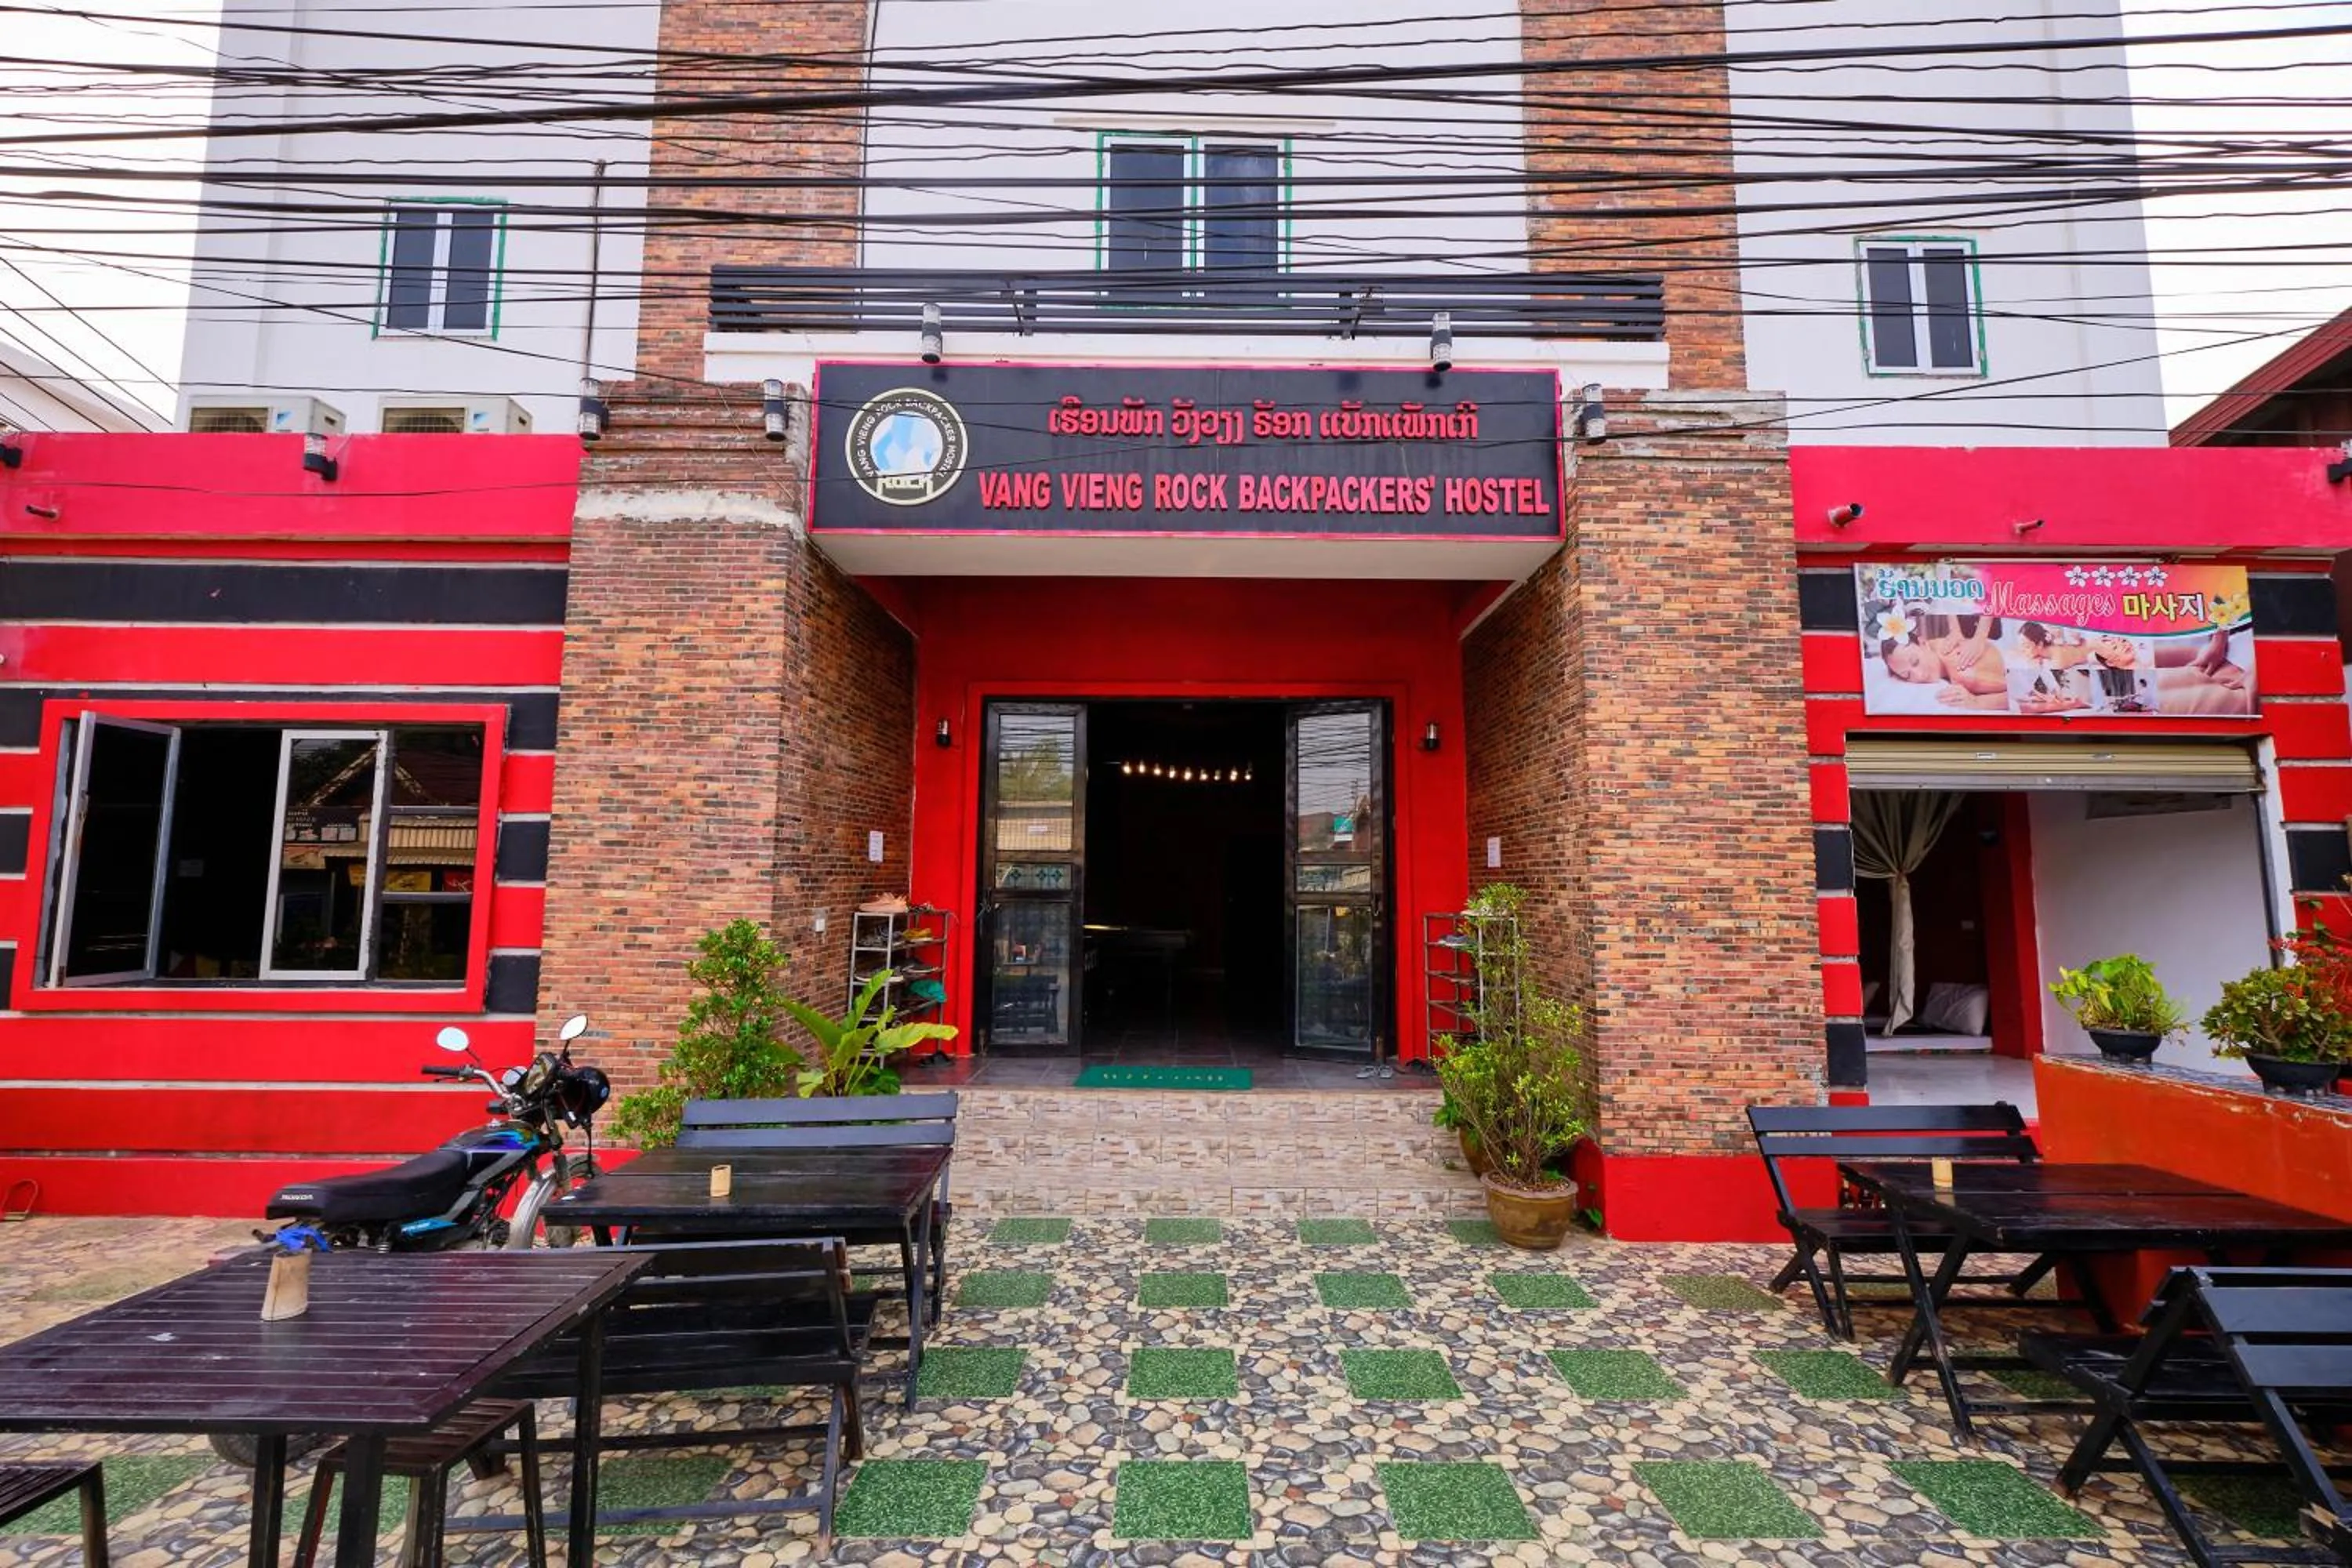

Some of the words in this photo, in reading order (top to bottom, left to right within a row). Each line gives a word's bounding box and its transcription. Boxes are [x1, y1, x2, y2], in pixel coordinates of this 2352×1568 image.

[856, 416, 876, 446] VIENG
[978, 470, 1052, 510] VANG
[1061, 472, 1143, 510] VIENG
[1154, 473, 1229, 511] ROCK
[1238, 474, 1436, 514] BACKPACKERS'
[1445, 477, 1551, 515] HOSTEL
[1983, 581, 2117, 626] Massages
[2122, 591, 2205, 622] 마사지
